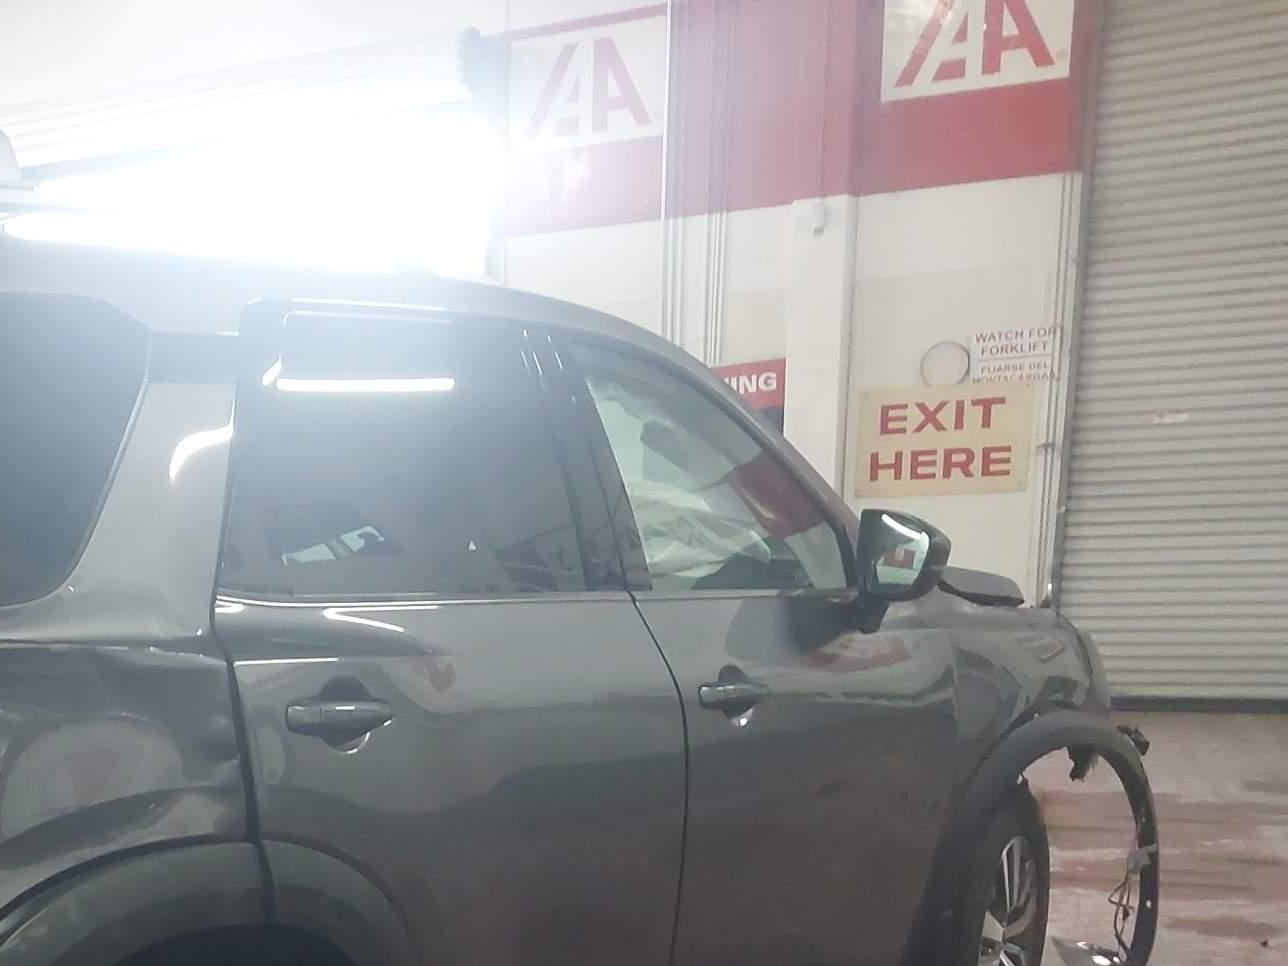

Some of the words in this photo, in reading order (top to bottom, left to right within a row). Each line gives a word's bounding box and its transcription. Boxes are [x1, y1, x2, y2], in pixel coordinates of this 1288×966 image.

[975, 329, 1024, 344] WATCH
[1028, 326, 1056, 339] FOR
[981, 340, 1049, 357] FORKLIFT
[724, 371, 777, 395] ING
[880, 396, 1007, 436] EXIT
[869, 445, 1012, 483] HERE
